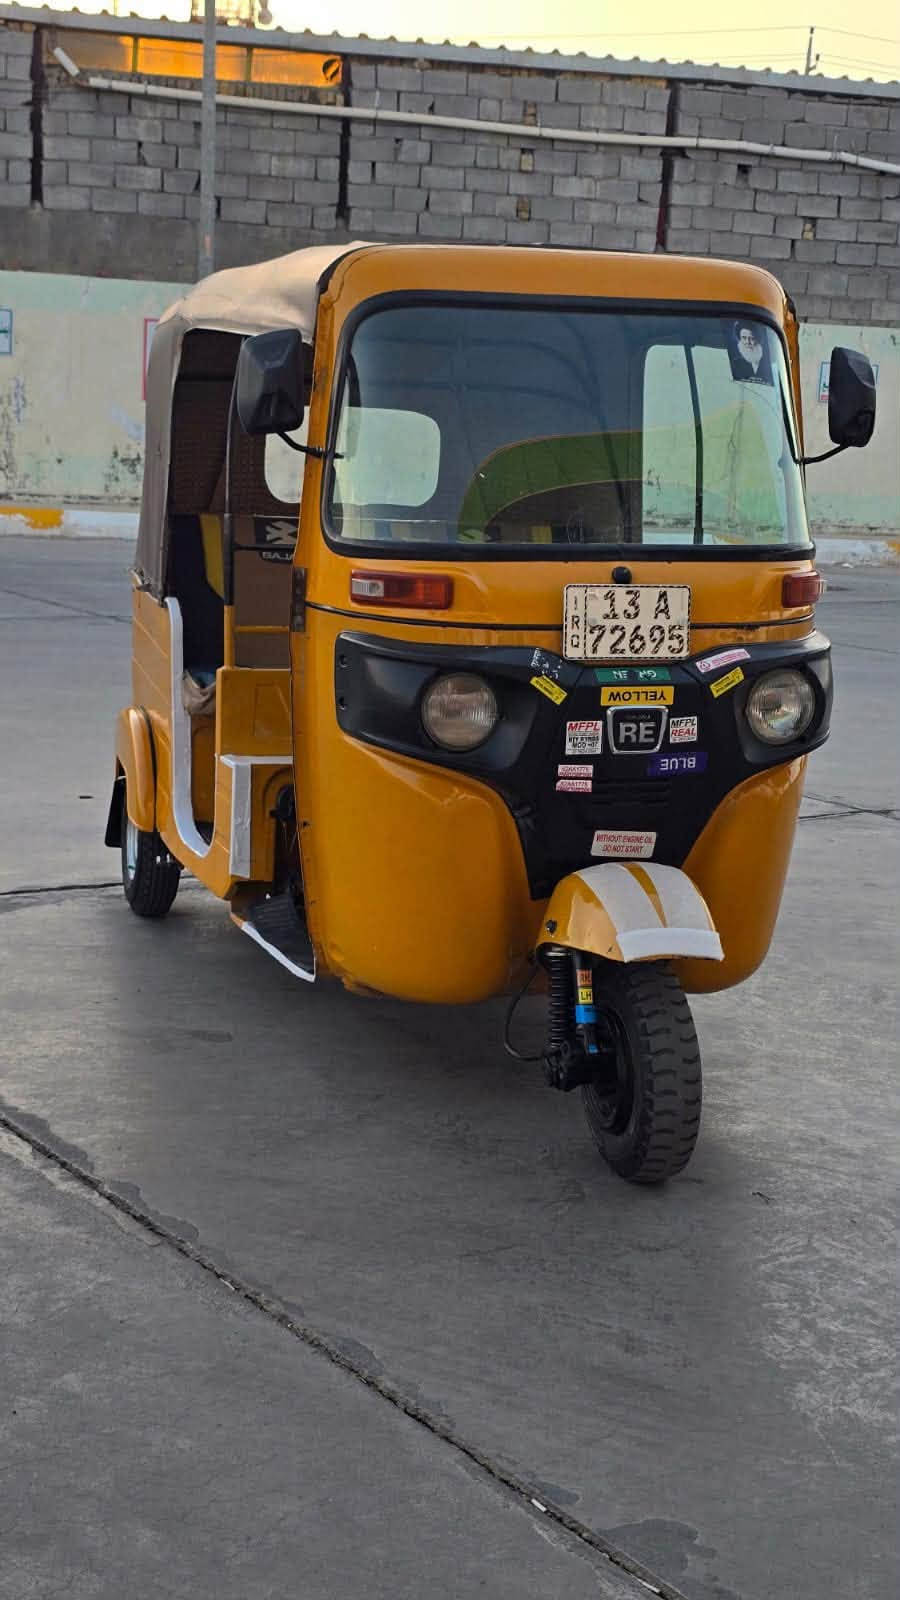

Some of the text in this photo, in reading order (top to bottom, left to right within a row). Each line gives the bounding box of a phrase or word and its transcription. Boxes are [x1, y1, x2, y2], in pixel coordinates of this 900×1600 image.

[603, 590, 671, 620] 13 A
[589, 624, 685, 655] 72695
[612, 670, 657, 680] GREN
[608, 691, 667, 702] YELLOW
[568, 721, 601, 731] MFPL
[670, 718, 697, 728] MFPL
[619, 721, 656, 743] RE
[671, 727, 696, 737] REAL
[660, 757, 696, 770] BLUE
[596, 834, 622, 842] WITHOUT
[622, 835, 644, 843] ENGINE
